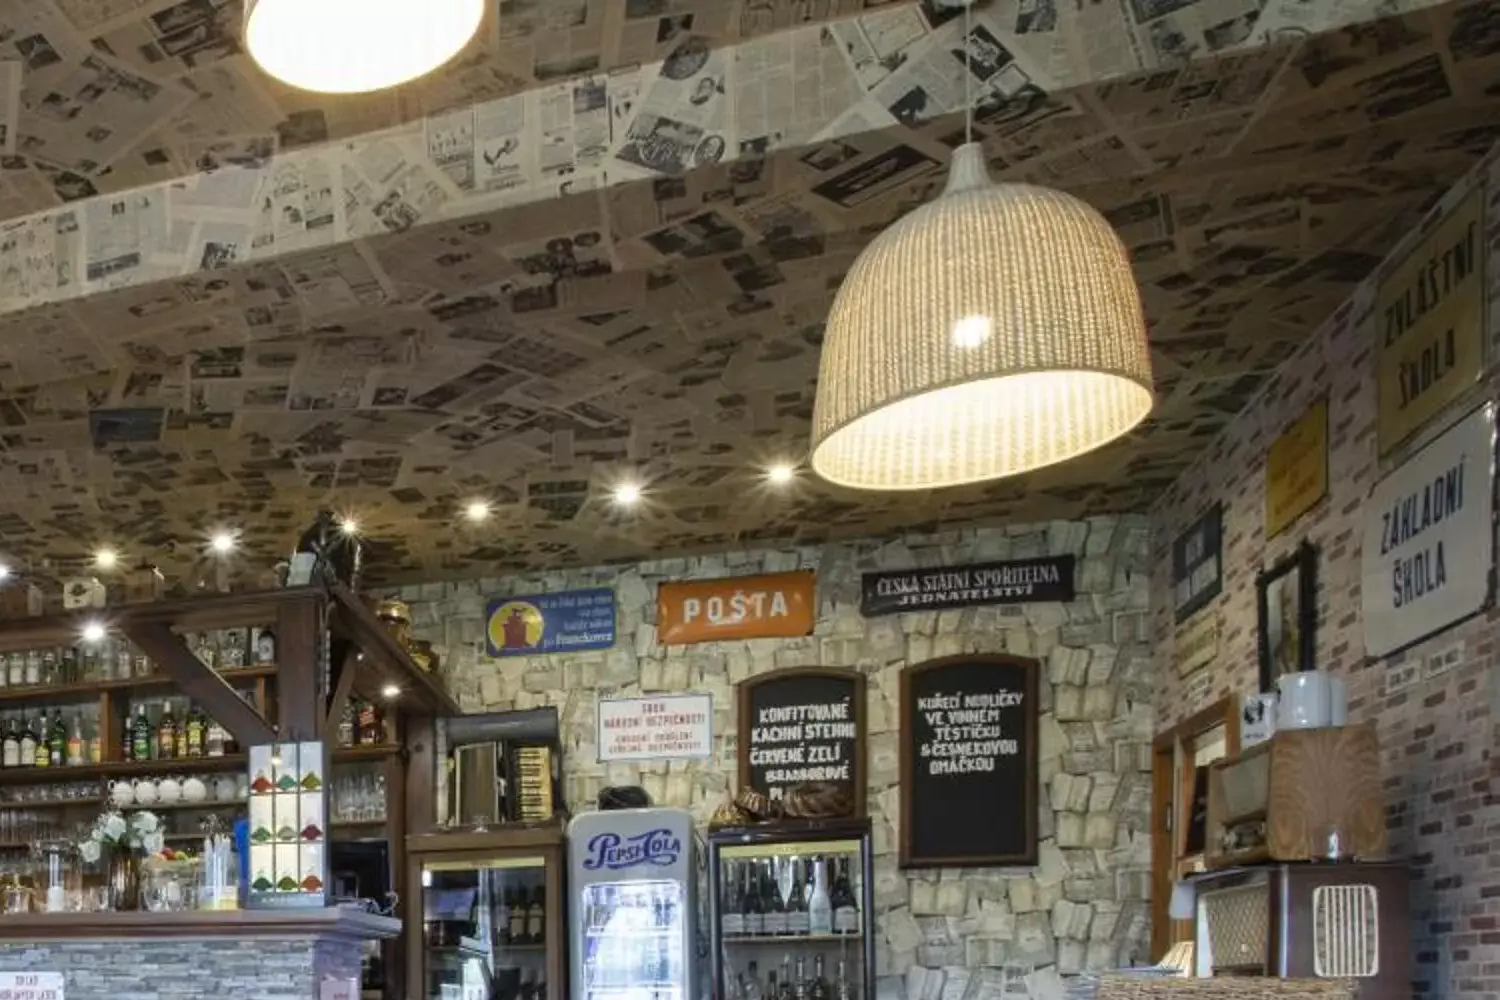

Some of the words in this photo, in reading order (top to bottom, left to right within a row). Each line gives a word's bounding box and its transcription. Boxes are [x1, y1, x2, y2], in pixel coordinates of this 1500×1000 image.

[1381, 452, 1467, 555] ZÁKLADNÍ
[1393, 541, 1446, 608] ŠKOLA
[683, 589, 789, 624] POŠTA
[758, 696, 851, 723] KONFITOVANÉ
[924, 711, 945, 726] VE
[749, 741, 805, 766] ČERVENÉ
[806, 740, 841, 763] ZELÍ
[929, 754, 995, 775] OMÁČKOU
